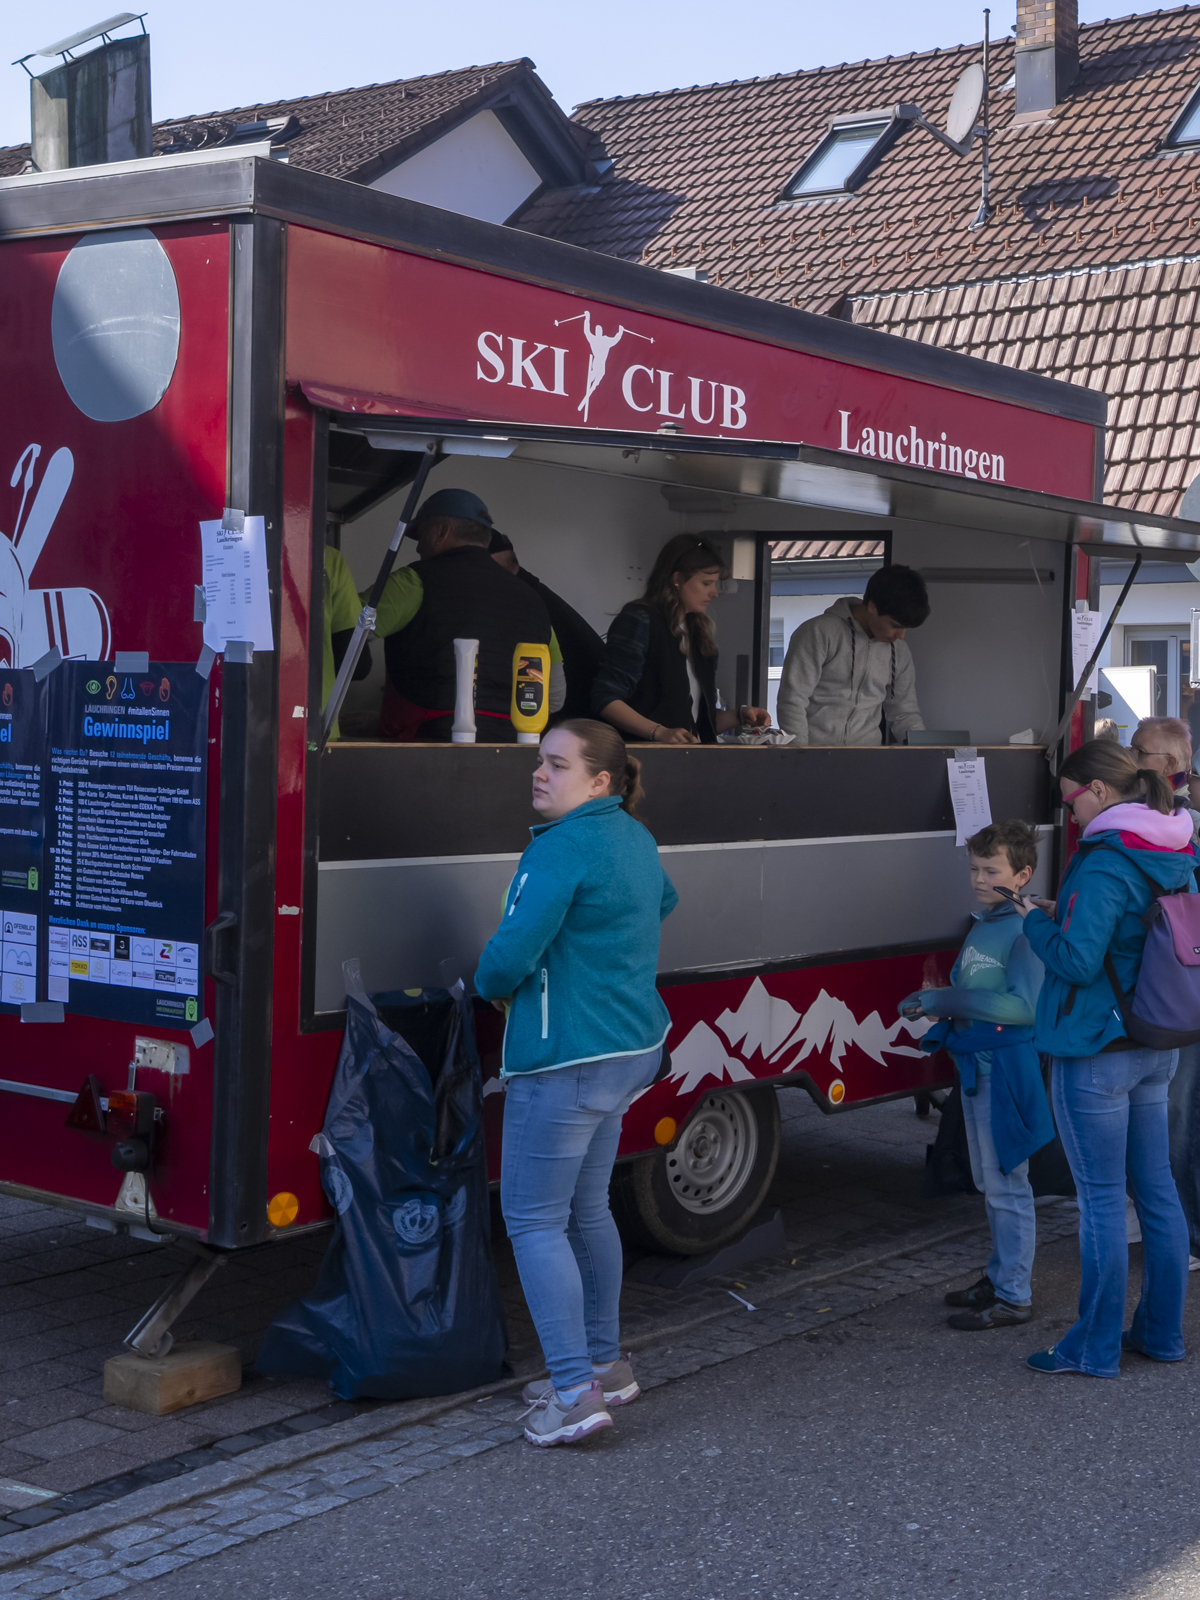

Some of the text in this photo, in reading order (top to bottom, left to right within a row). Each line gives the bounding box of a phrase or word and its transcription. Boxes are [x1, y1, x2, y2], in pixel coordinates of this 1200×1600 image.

[476, 330, 749, 430] SKI CLUB
[838, 410, 1006, 483] Lauchringen
[84, 704, 126, 714] LAUCHRINGEN
[83, 716, 170, 745] Gewinnspiel
[76, 918, 89, 927] Dank
[72, 934, 88, 948] ASS
[156, 999, 185, 1008] LAUCHRINGEN
